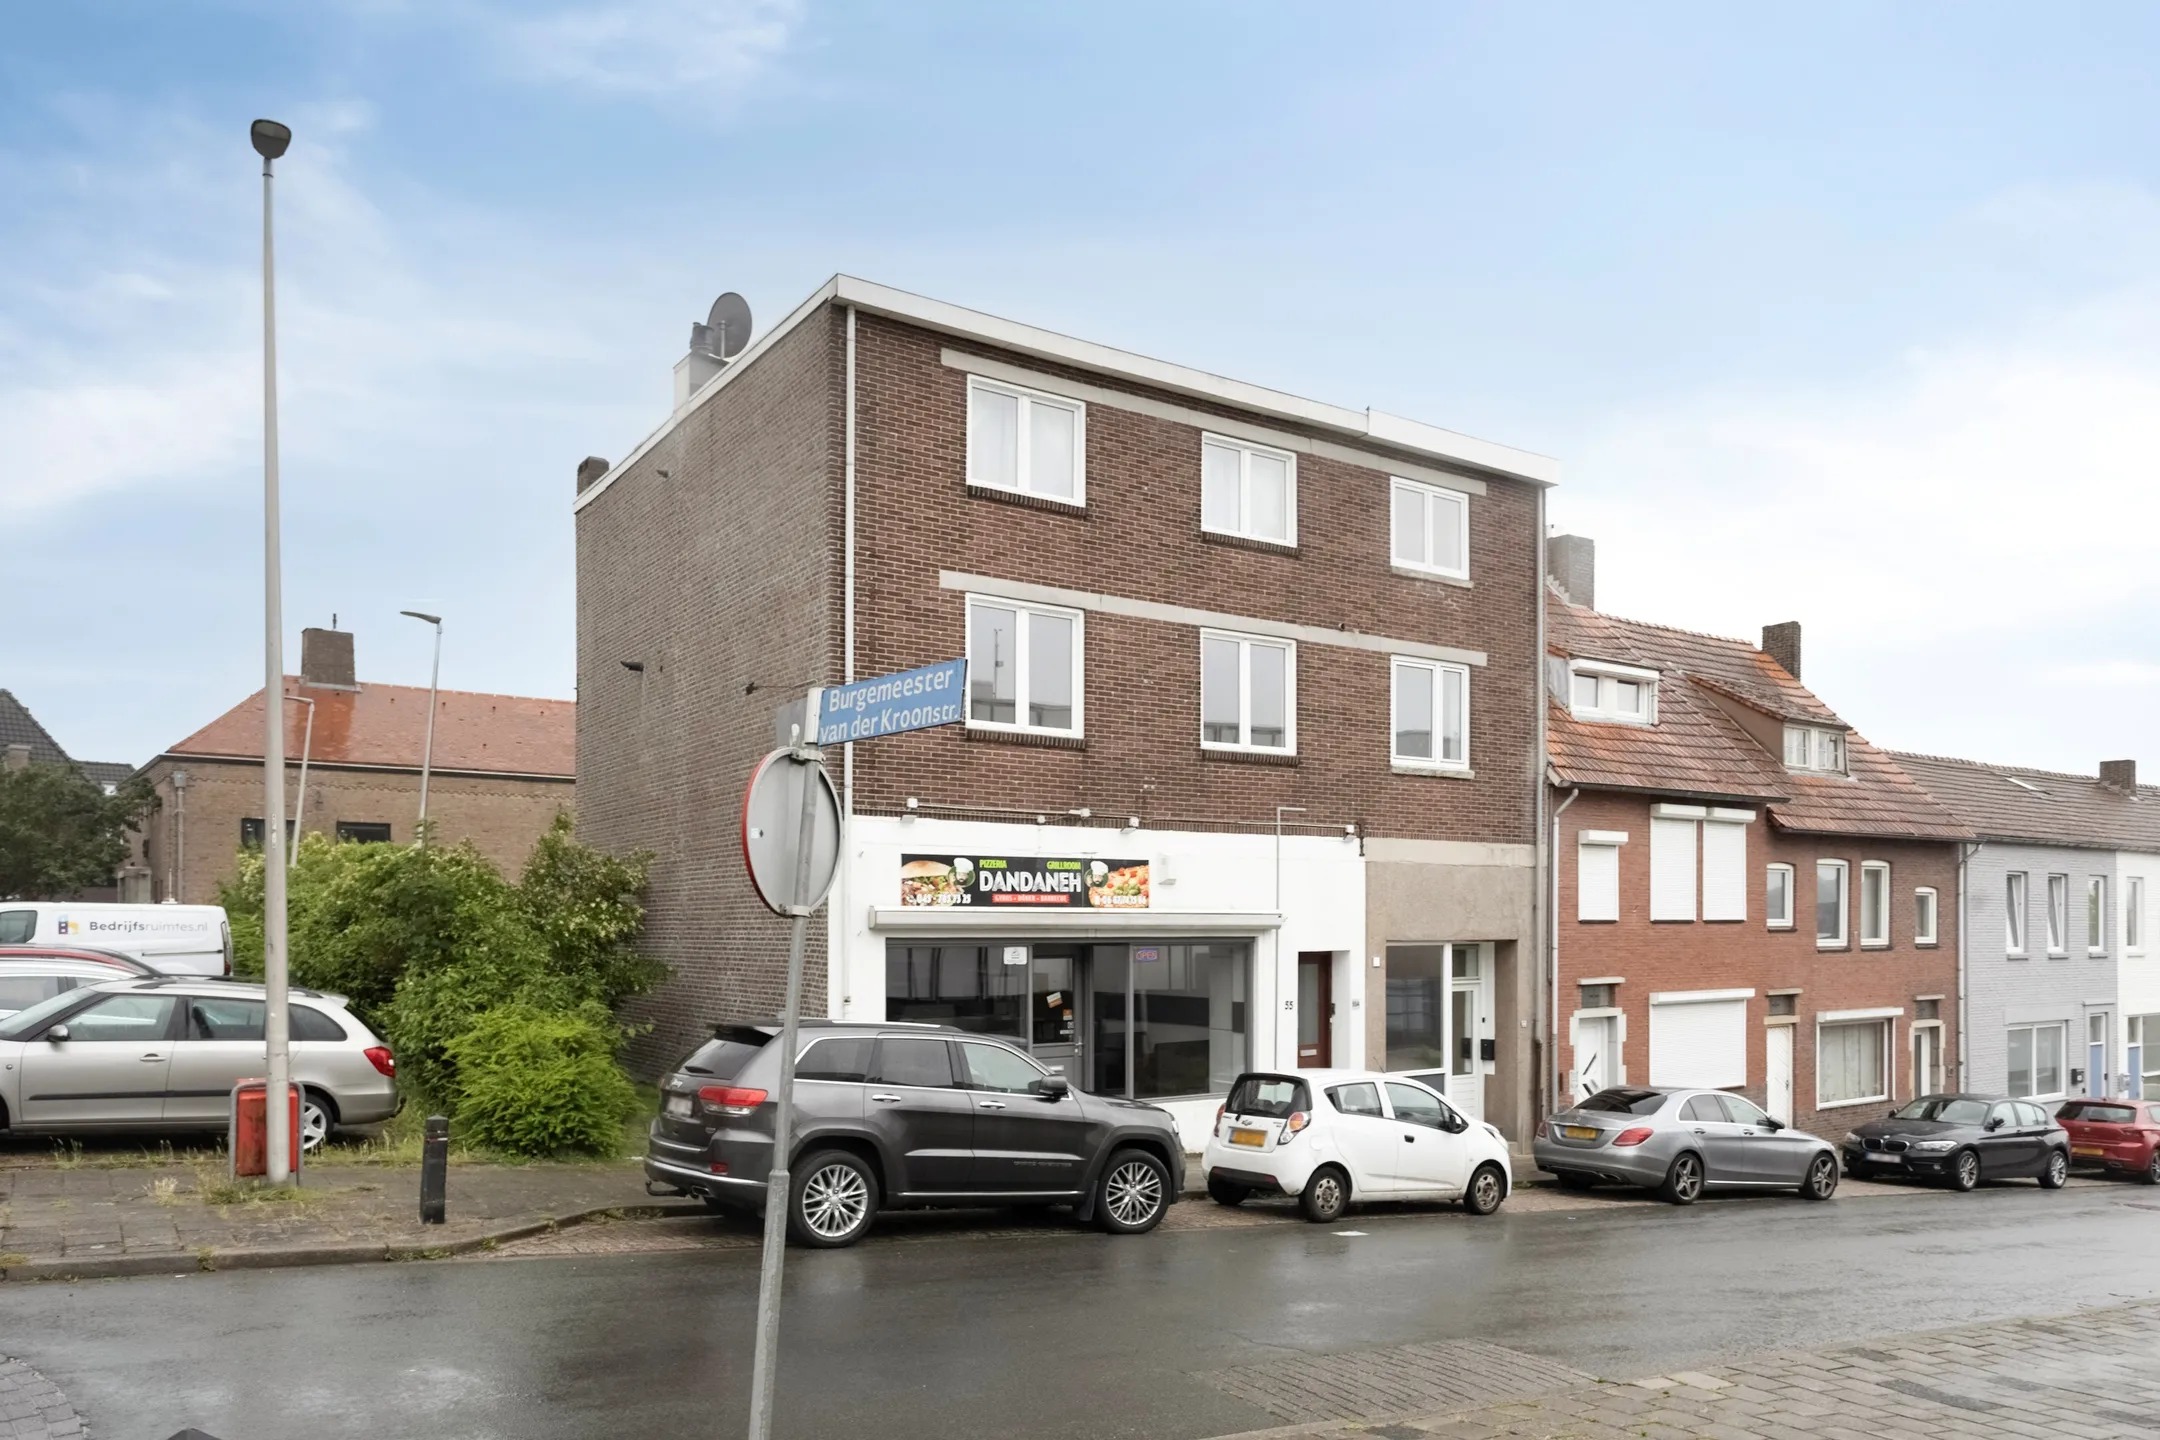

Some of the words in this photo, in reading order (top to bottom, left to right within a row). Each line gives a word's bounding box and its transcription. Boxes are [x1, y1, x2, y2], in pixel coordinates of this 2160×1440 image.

[828, 669, 953, 712] Burgemeester
[820, 721, 848, 743] van
[851, 715, 878, 738] der
[881, 704, 958, 732] Kroonstr.
[979, 859, 1007, 868] PIZZERIA
[1047, 861, 1081, 870] GRILLROOM
[979, 870, 1082, 892] DANDANEH
[89, 920, 208, 933] Bedrijfsruimtes.nl
[1136, 950, 1158, 960] OPEN
[1284, 1000, 1294, 1010] 55
